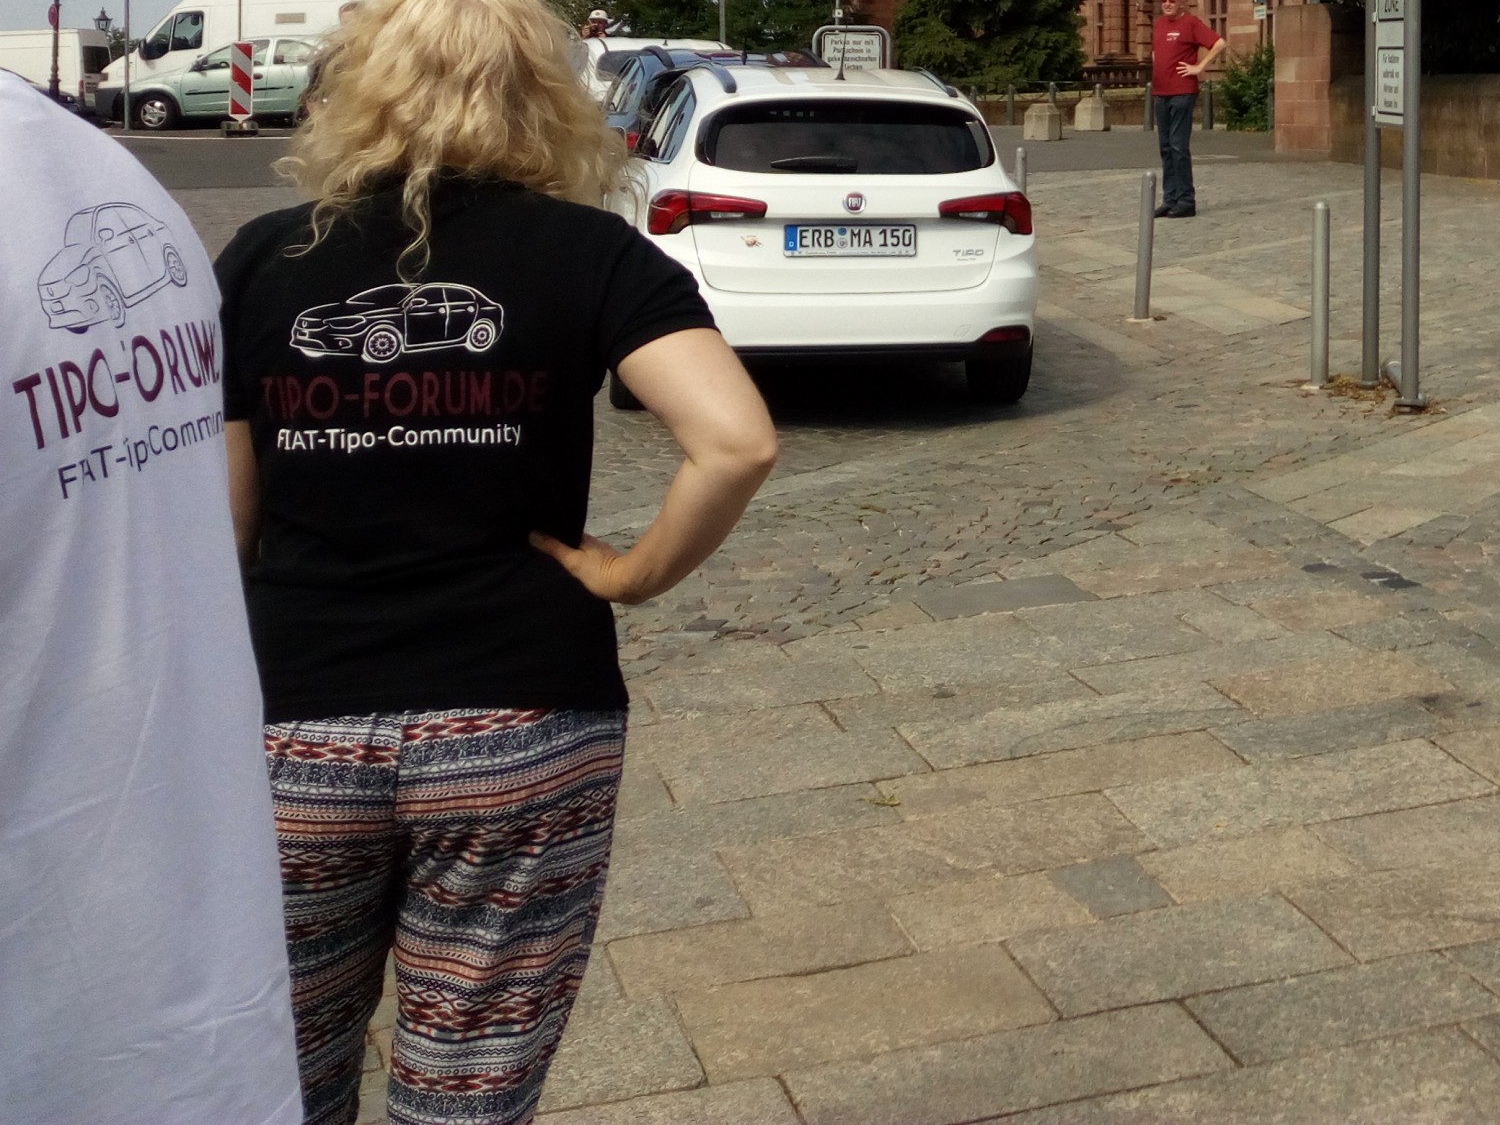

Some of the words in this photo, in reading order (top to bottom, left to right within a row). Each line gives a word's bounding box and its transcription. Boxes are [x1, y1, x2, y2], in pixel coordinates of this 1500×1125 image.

[848, 196, 862, 208] FIAT
[799, 228, 834, 248] ERB
[850, 228, 873, 248] MA
[879, 228, 912, 247] 150
[952, 249, 984, 257] TIPO
[260, 370, 548, 420] TIPO-FORUM.DE
[277, 424, 521, 453] FIAT-Tipo-Community
